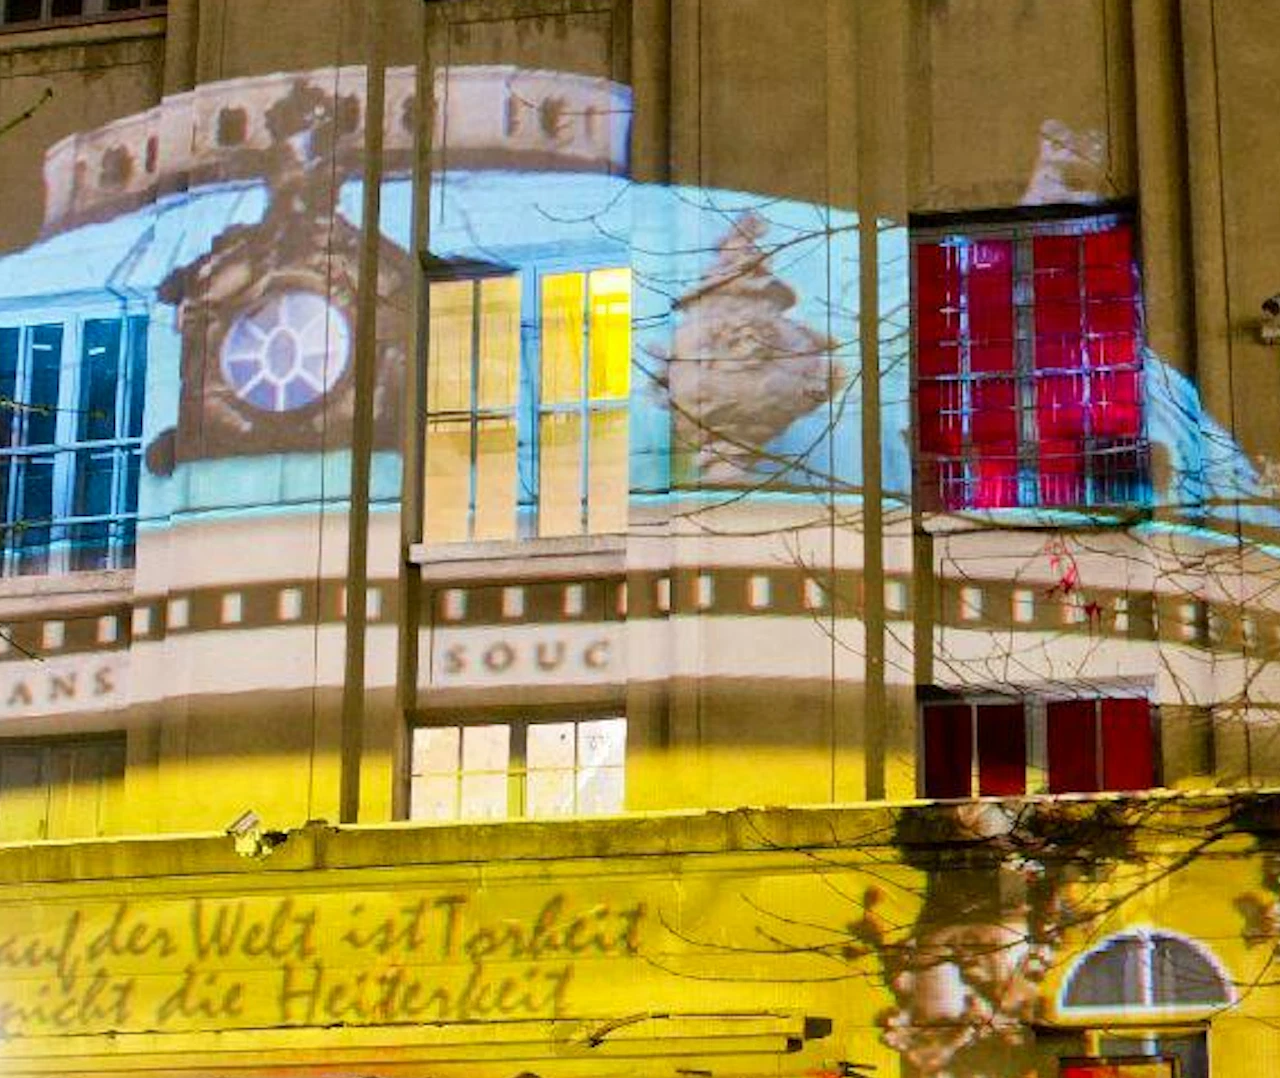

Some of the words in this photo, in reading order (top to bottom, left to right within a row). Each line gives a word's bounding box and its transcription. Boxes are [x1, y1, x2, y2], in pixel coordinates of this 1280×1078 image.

[443, 638, 613, 674] SOUC
[87, 899, 180, 961] der
[192, 896, 318, 960] Welt
[156, 964, 245, 1024] die
[276, 956, 574, 1024] Heiterkeit
